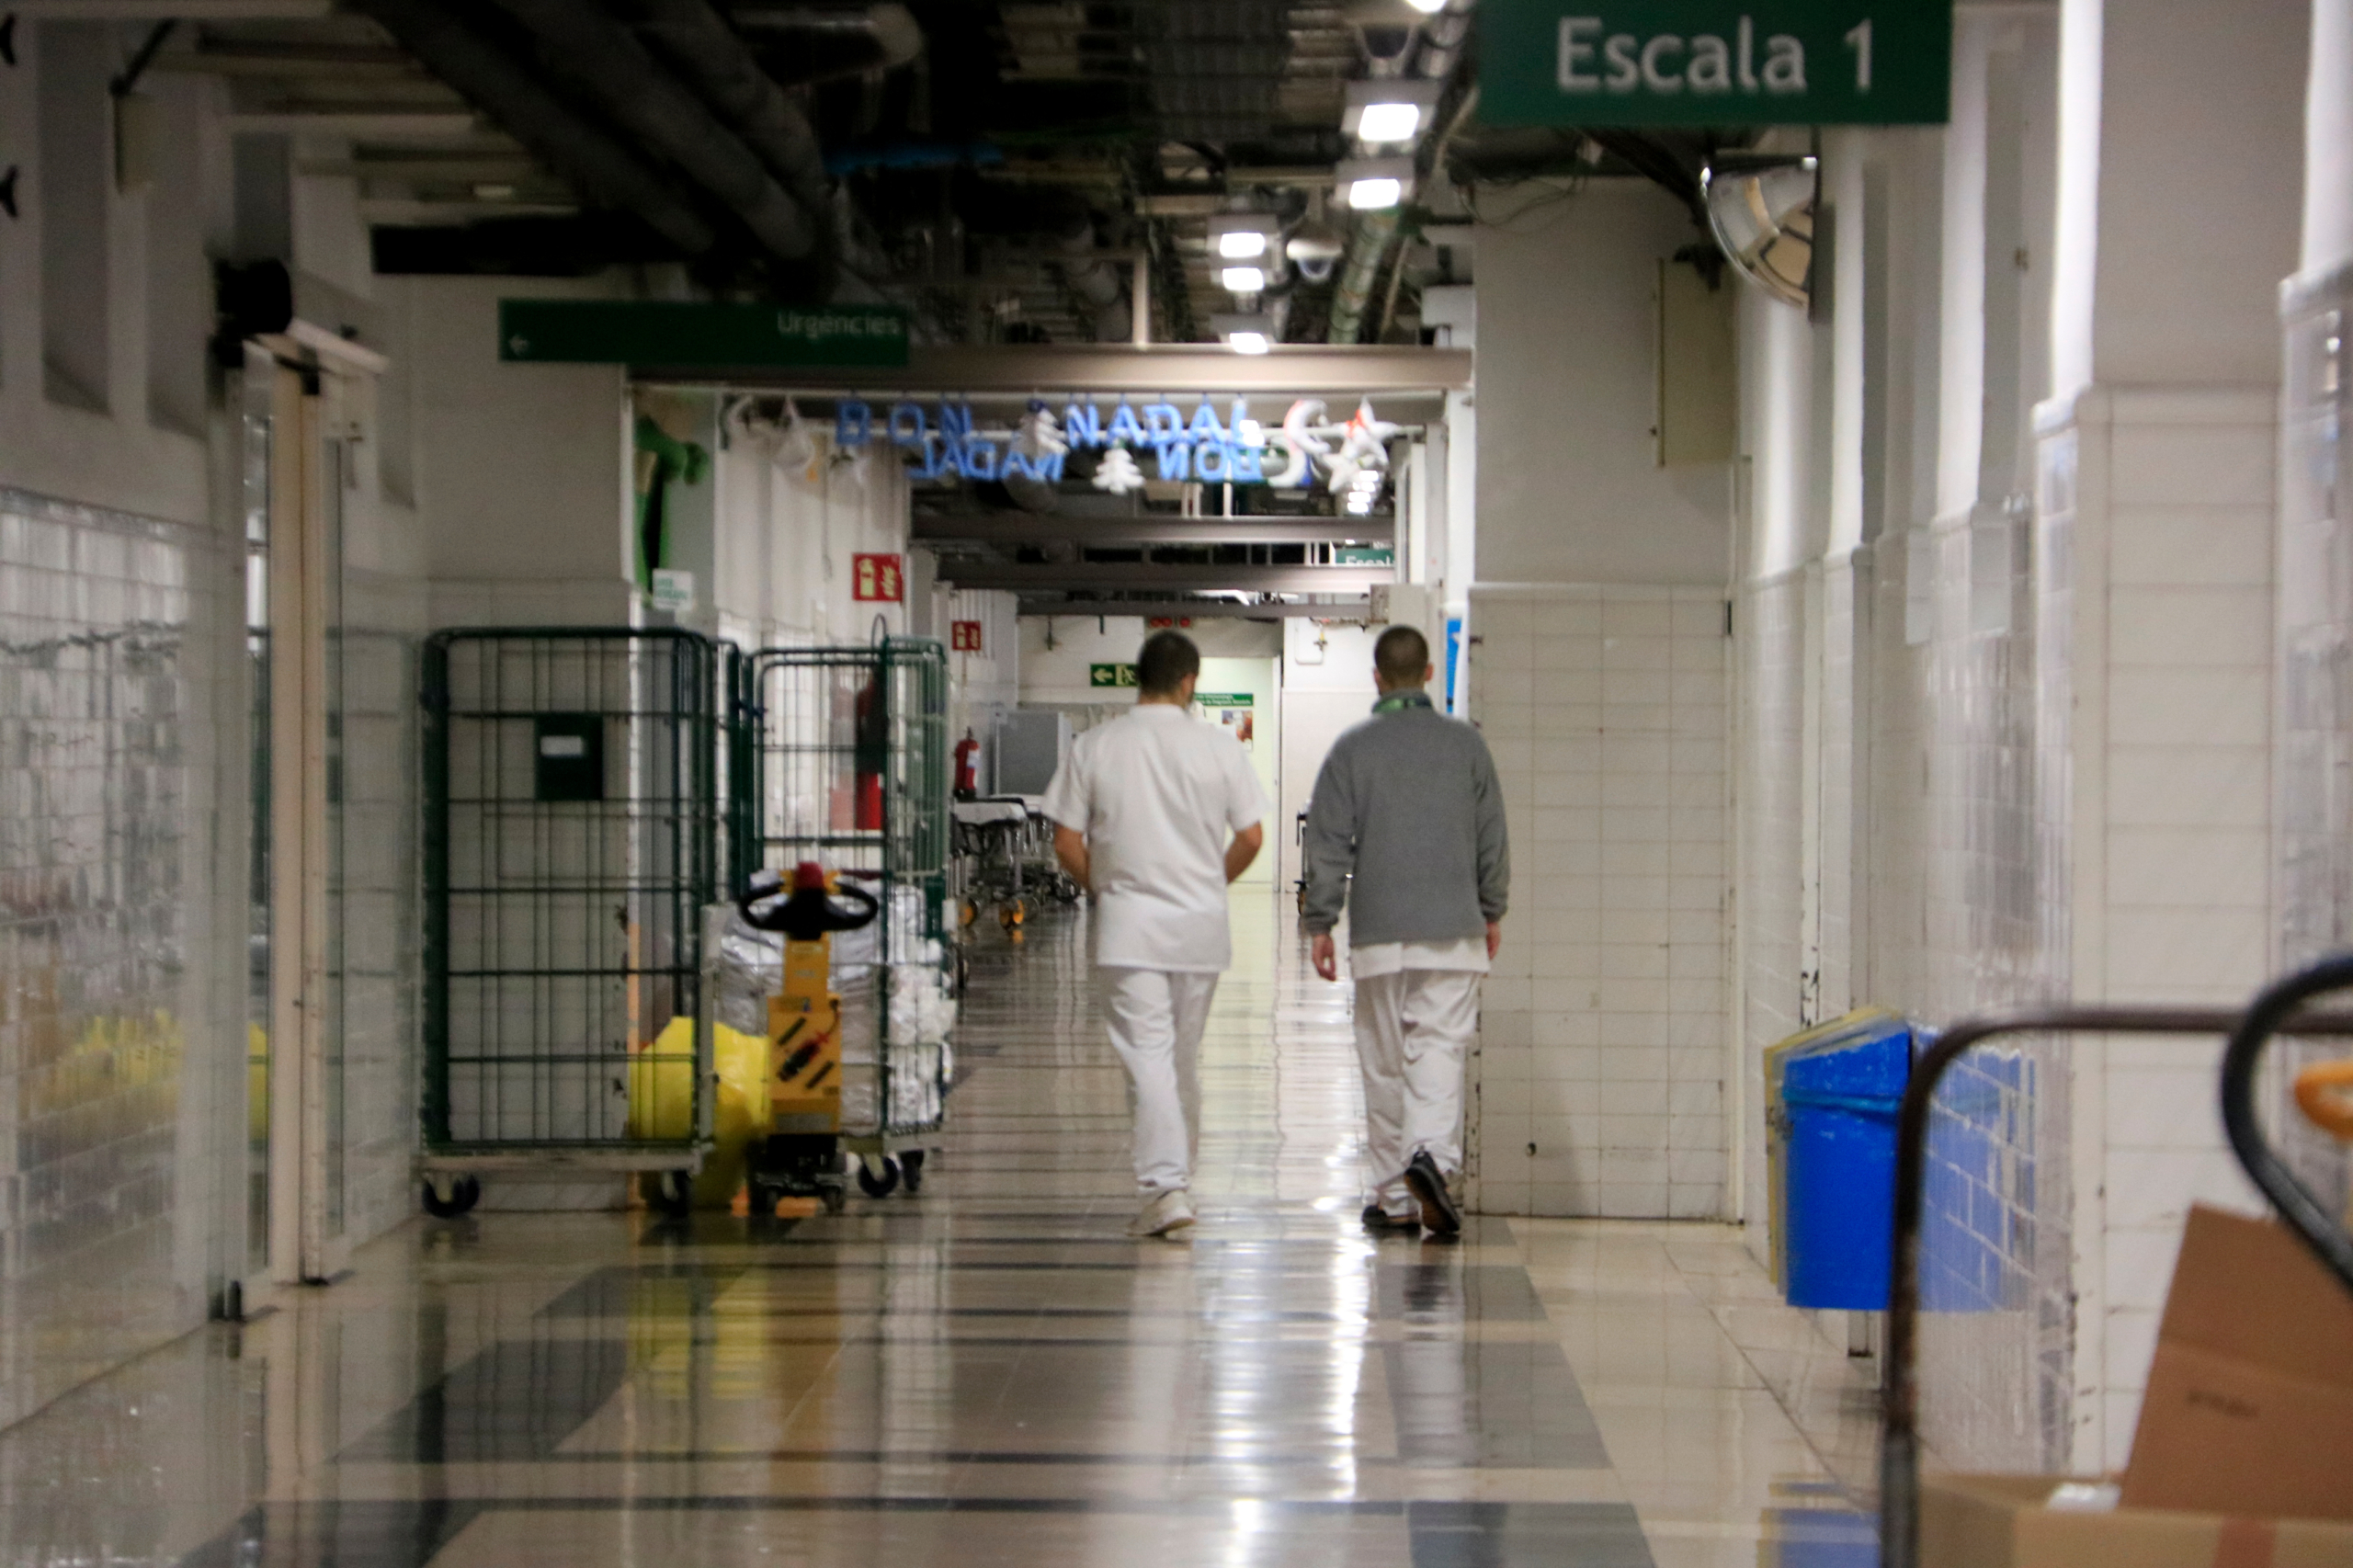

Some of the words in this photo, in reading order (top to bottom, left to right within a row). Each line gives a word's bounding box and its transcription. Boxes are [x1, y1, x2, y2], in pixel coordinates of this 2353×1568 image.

[1557, 16, 1806, 91] Escala
[1844, 17, 1871, 90] 1
[835, 400, 972, 446] BON
[1066, 399, 1263, 448] NADAL
